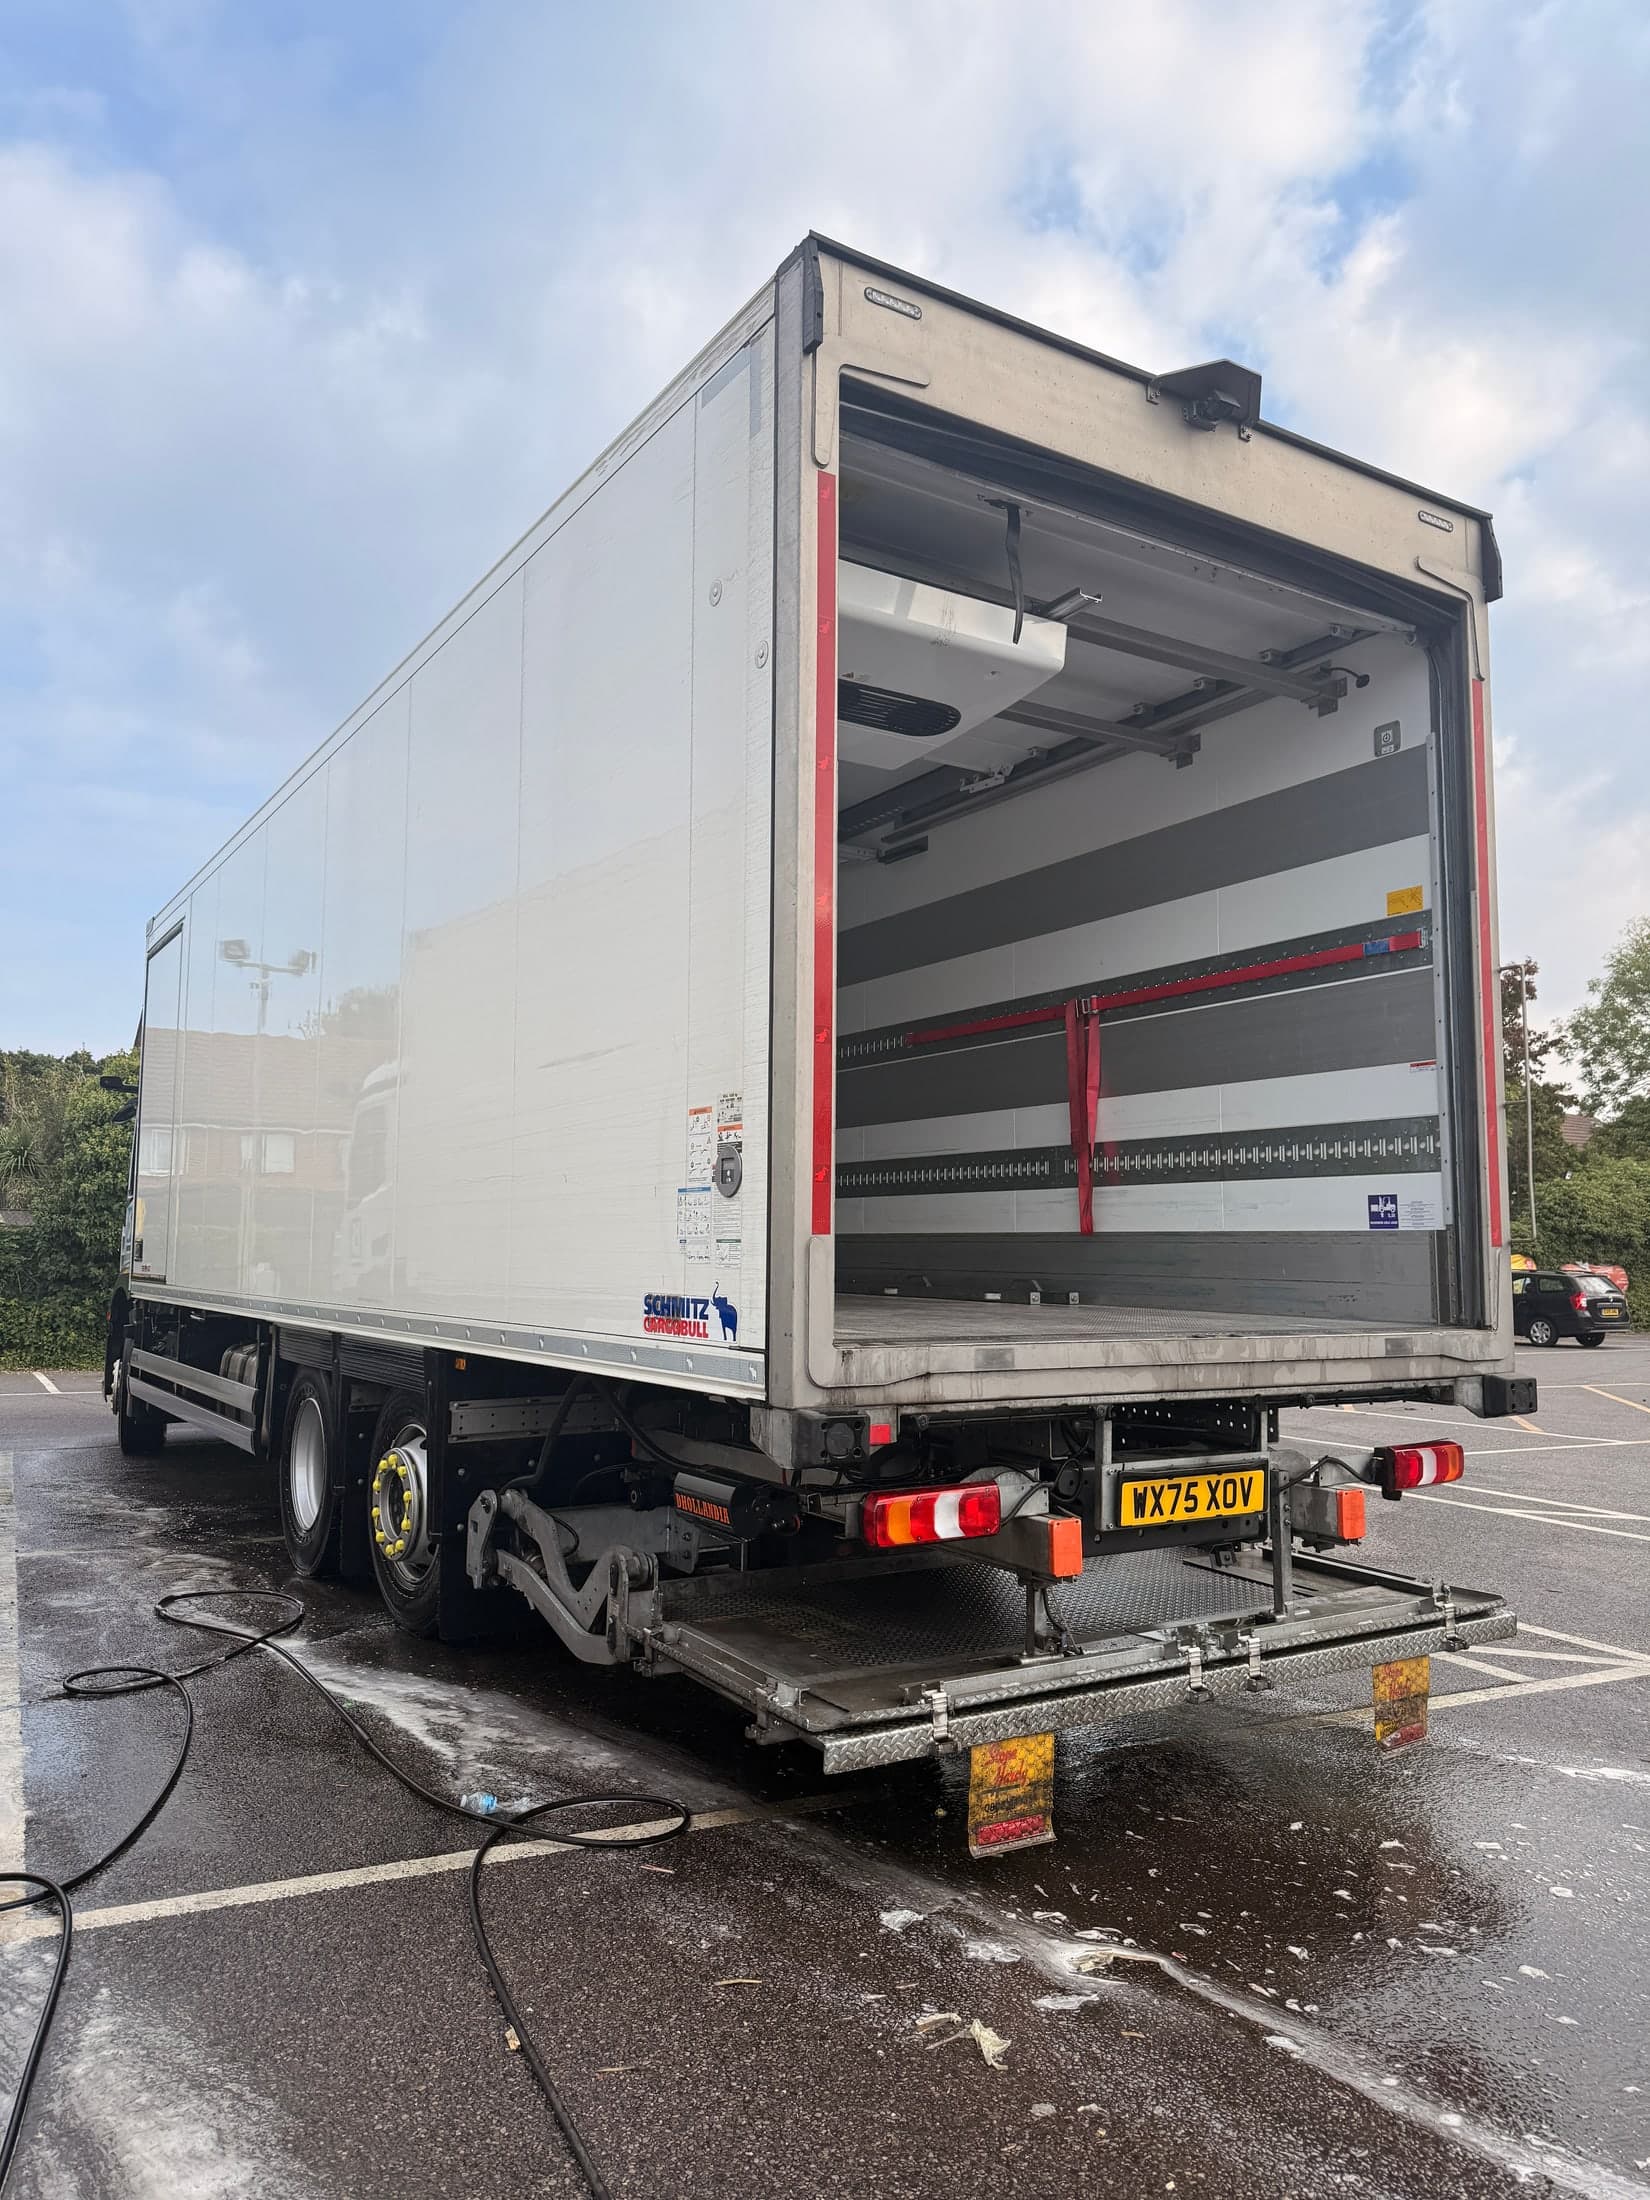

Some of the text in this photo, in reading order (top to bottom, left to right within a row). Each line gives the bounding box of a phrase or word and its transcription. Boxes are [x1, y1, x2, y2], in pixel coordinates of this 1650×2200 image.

[644, 1294, 710, 1320] SCHMITZ
[643, 1316, 709, 1338] CARGOBULL
[675, 1492, 731, 1524] DHOLLANDIA
[1133, 1476, 1253, 1519] WX75 XOV
